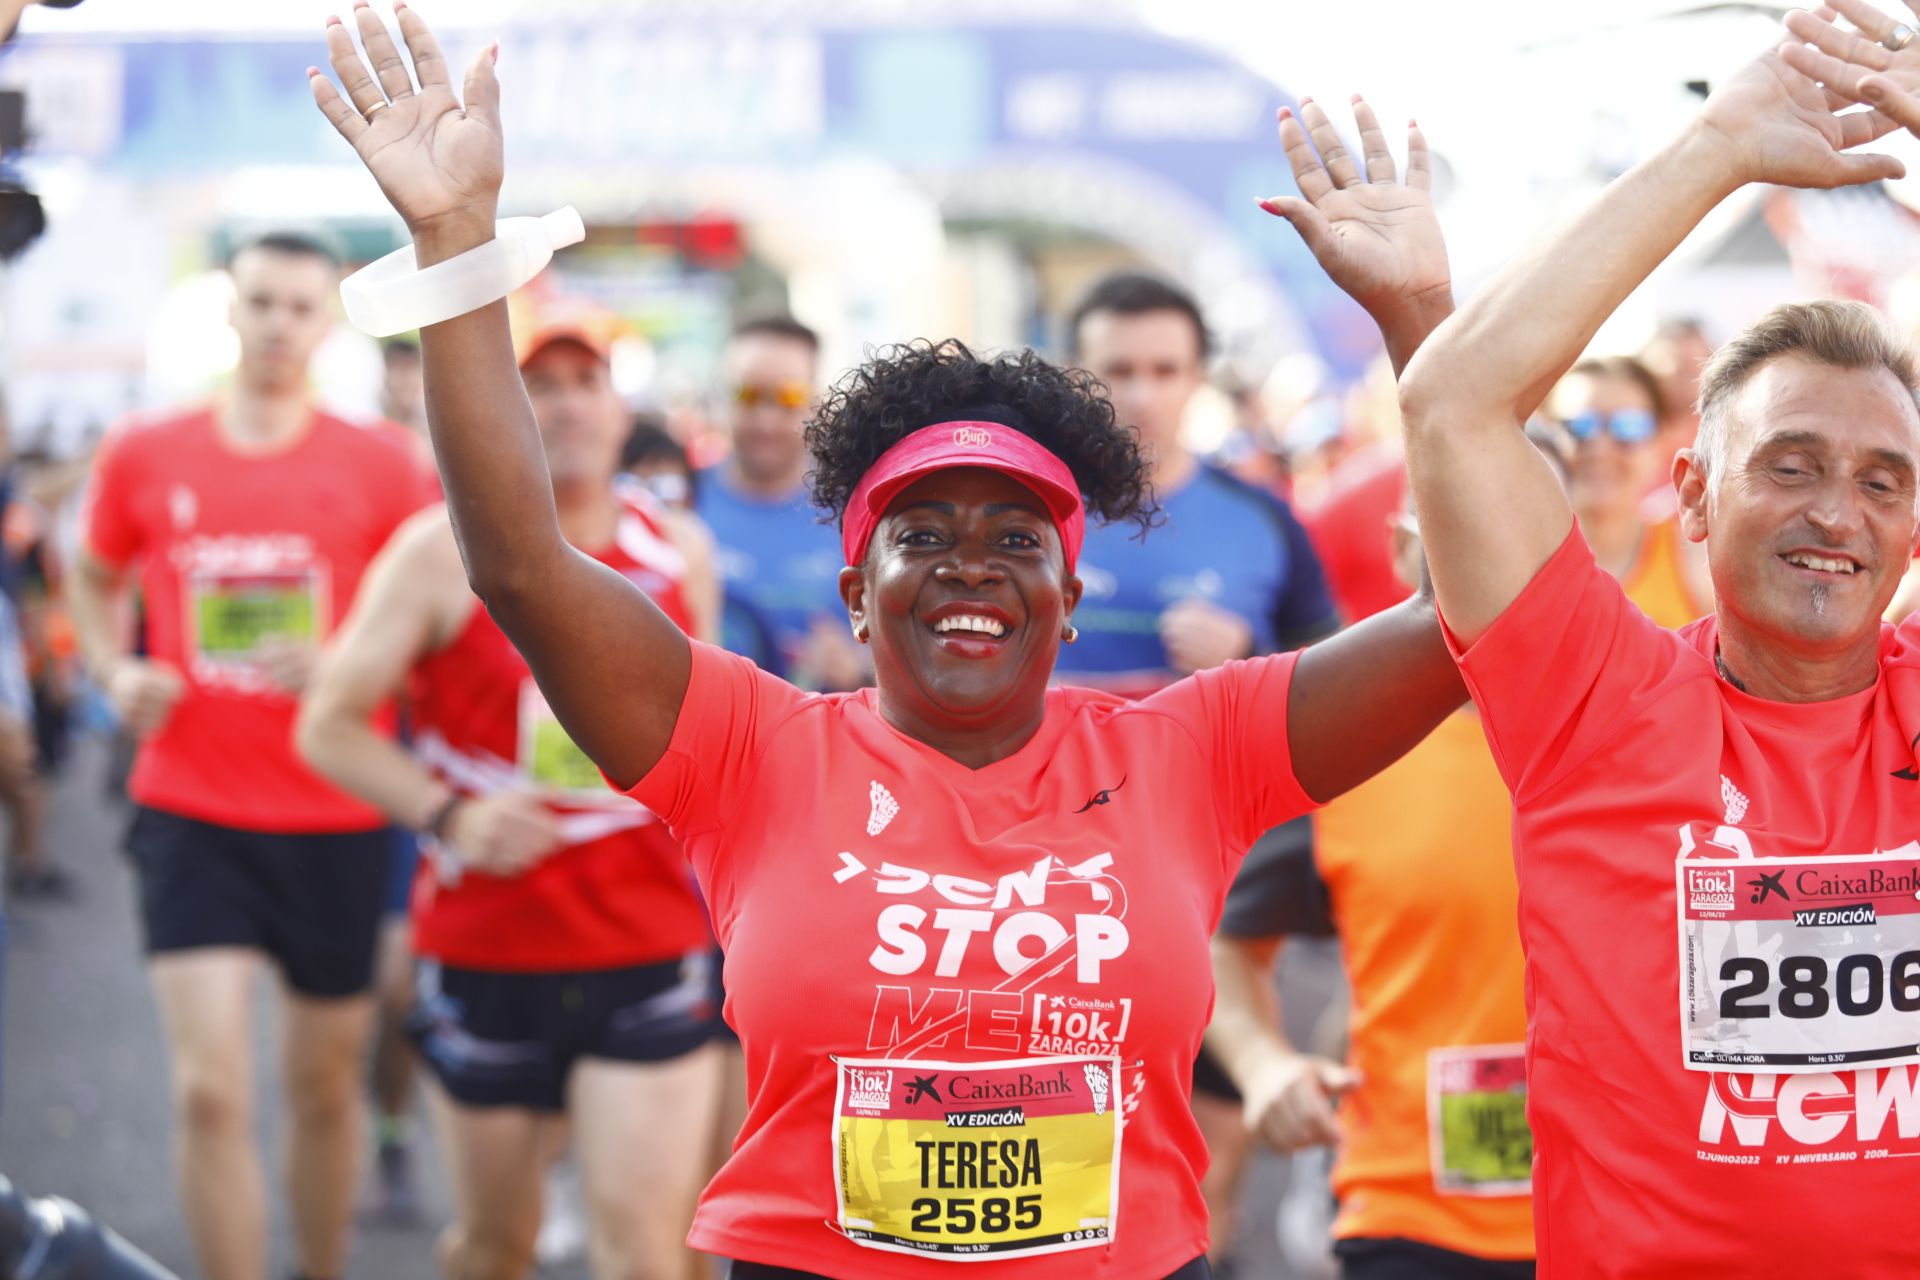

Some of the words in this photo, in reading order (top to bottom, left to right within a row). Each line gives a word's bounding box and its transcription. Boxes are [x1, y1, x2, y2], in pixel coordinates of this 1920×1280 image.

[1696, 877, 1727, 893] 10k
[1690, 892, 1734, 904] ZARAGOZA
[1795, 912, 1816, 925] XV
[1818, 907, 1875, 925] EDICIÓN
[869, 904, 1129, 984] STOP
[1719, 950, 1920, 1019] 2806
[1068, 997, 1115, 1010] CaixaBank
[866, 985, 1024, 1053] ME
[1028, 1033, 1120, 1056] ZARAGOZA
[1743, 1055, 1765, 1063] HORA
[948, 1070, 1073, 1100] CaixaBank
[850, 1090, 890, 1102] ZARAGOZA
[947, 1113, 966, 1126] XV
[968, 1109, 1024, 1126] EDICIÓN
[915, 1138, 1042, 1188] TERESA
[1696, 1150, 1761, 1165] 12JUNIO2022
[1776, 1155, 1789, 1165] XV
[1793, 1152, 1858, 1165] ANIVERSARIO
[911, 1193, 1042, 1234] 2585
